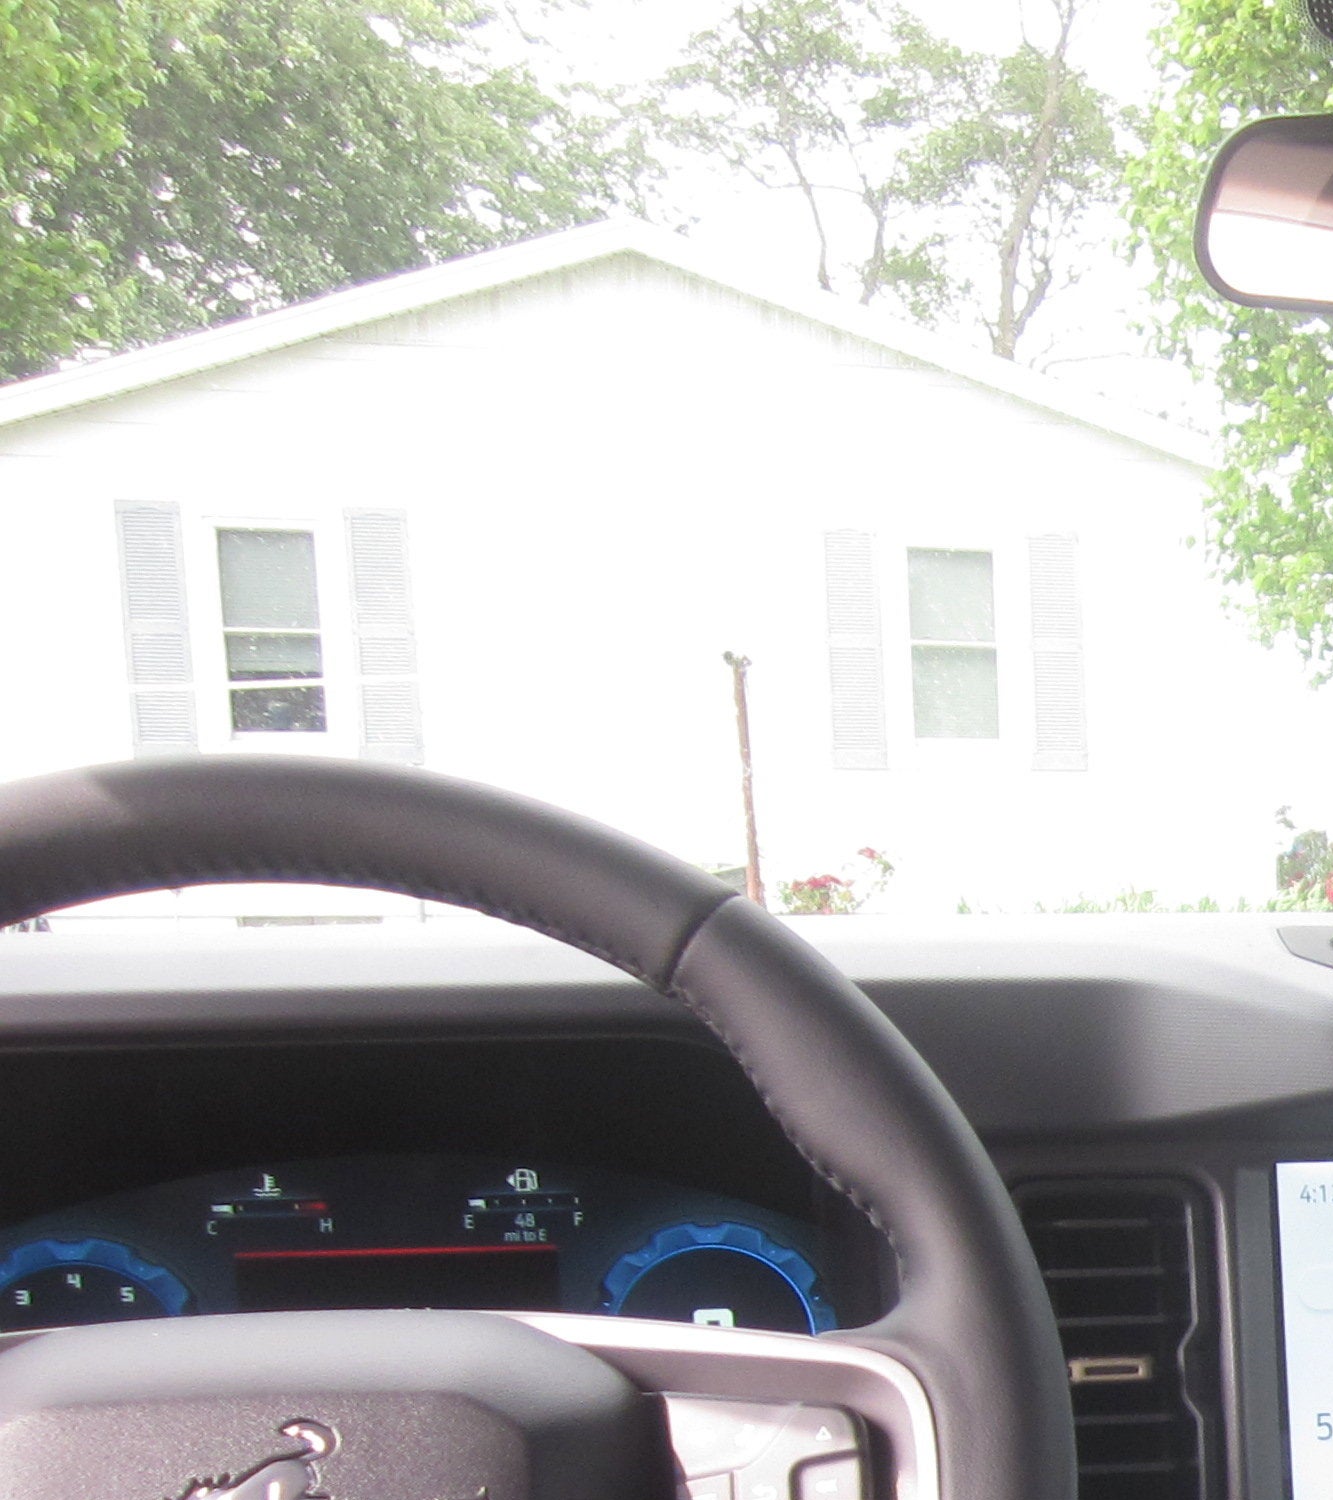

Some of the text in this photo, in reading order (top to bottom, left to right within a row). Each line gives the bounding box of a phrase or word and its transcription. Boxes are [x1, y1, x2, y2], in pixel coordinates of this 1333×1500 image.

[319, 1217, 334, 1233] H
[463, 1214, 474, 1230] E
[513, 1212, 536, 1228] 48
[573, 1211, 584, 1227] F
[66, 1273, 82, 1290] 4
[15, 1289, 32, 1306] 3
[120, 1286, 136, 1303] 5
